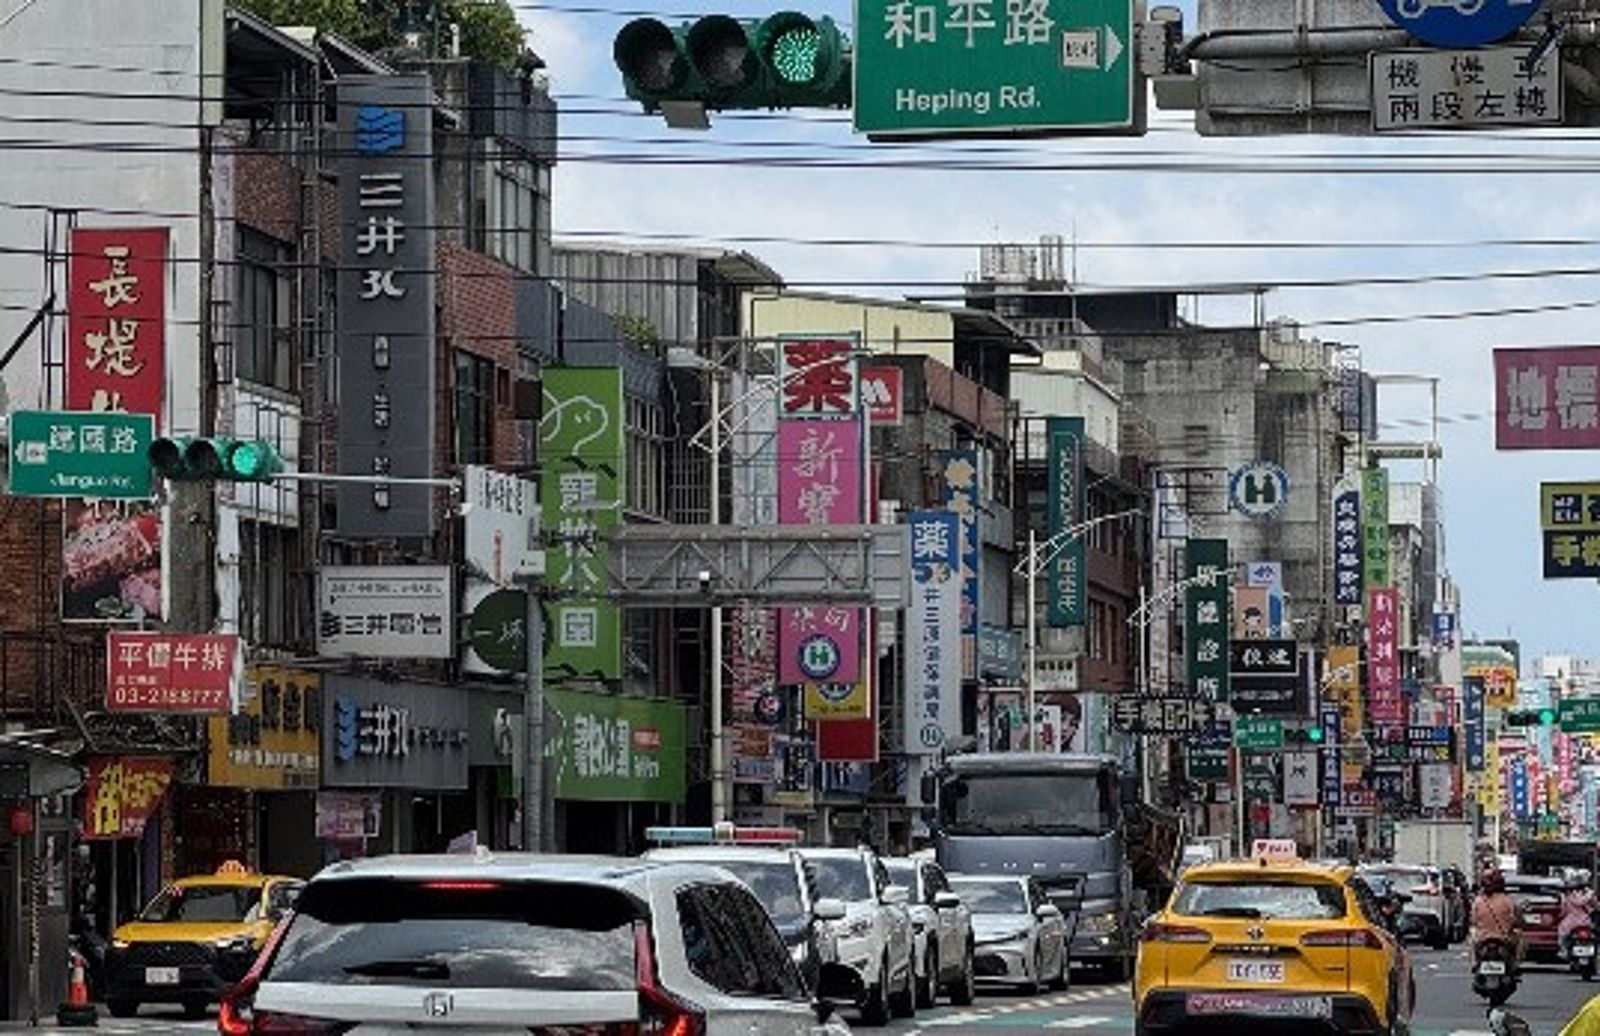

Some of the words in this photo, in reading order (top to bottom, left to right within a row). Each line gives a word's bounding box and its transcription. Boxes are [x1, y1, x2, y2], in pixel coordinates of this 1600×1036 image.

[884, 0, 1056, 48] 和平路
[895, 88, 992, 114] Heping
[999, 86, 1041, 109] Rd.
[1387, 87, 1548, 123] 兩段左轉
[48, 424, 138, 453] 建國路
[118, 641, 227, 671] 平價牛排
